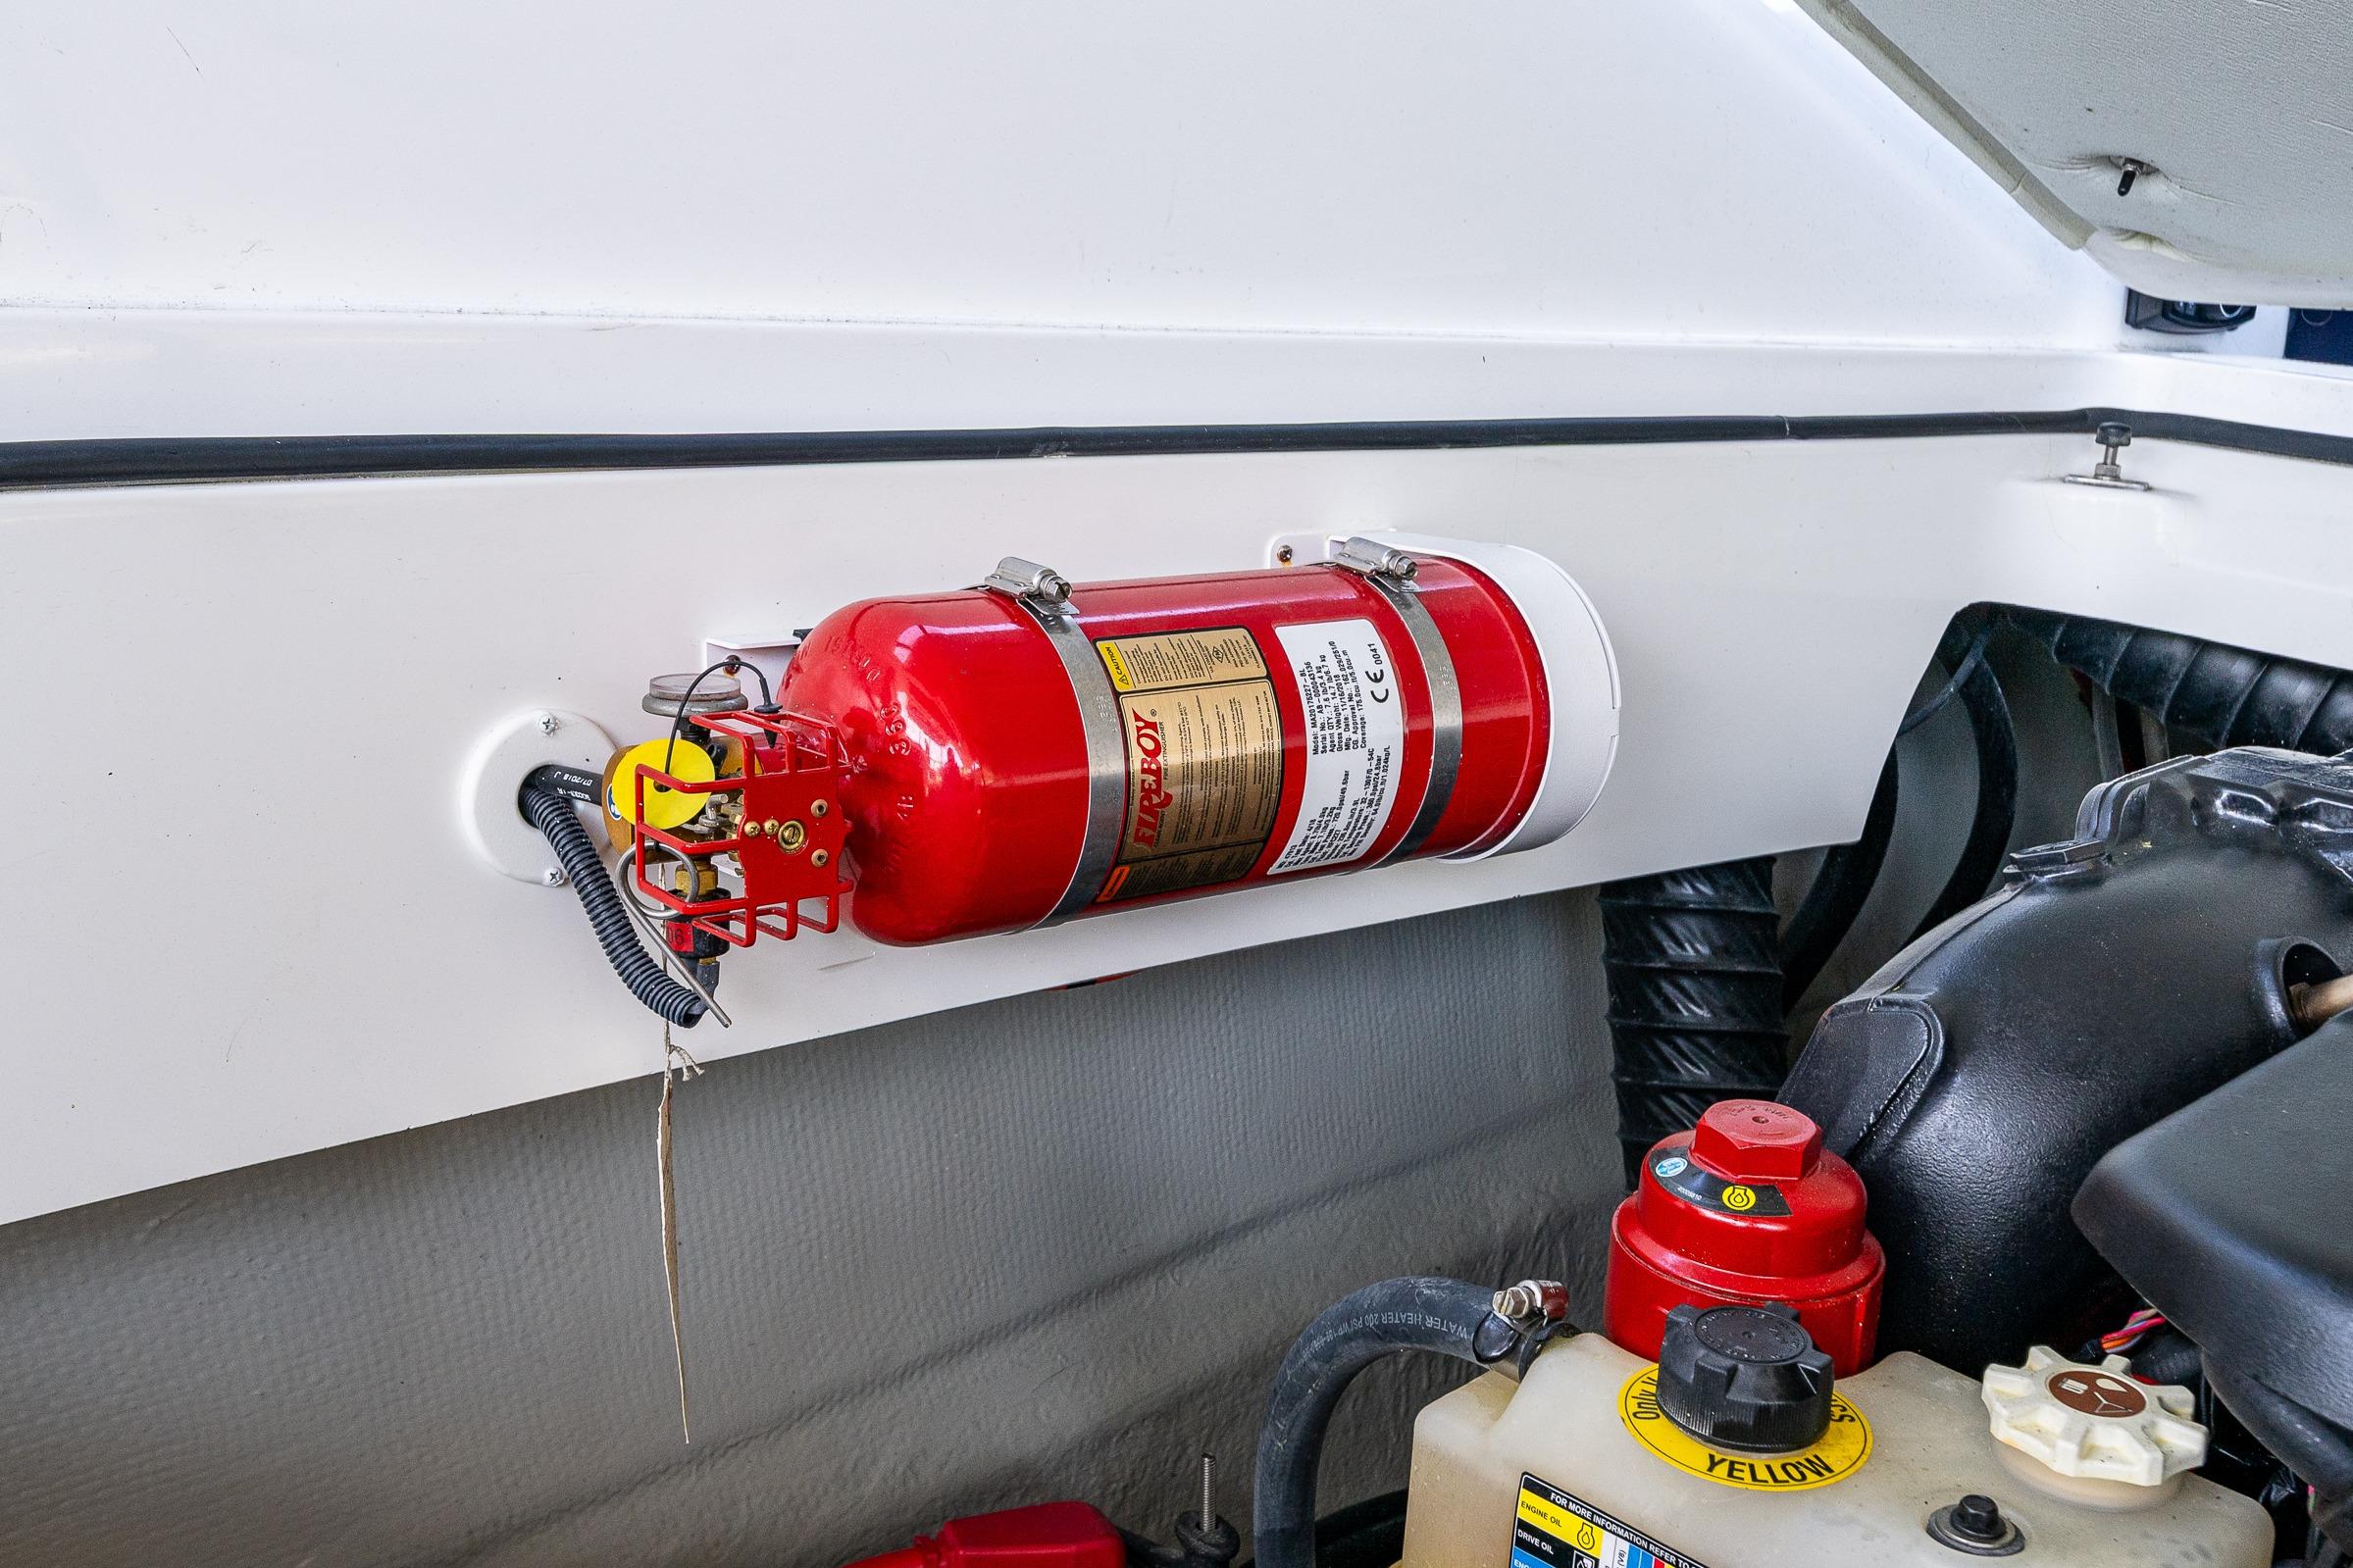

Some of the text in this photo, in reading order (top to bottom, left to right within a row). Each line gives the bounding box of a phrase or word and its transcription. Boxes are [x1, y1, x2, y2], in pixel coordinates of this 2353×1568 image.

[1105, 647, 1122, 675] CAUTION
[1367, 643, 1383, 665] 0041
[1333, 703, 1343, 730] Weight:
[1350, 705, 1358, 734] Approval
[1159, 722, 1168, 766] EXTINGUISHER
[1327, 733, 1336, 752] Agent
[563, 774, 592, 785] 07/2018
[1132, 708, 1173, 848] FIREBOY
[1364, 1313, 1378, 1328] 200
[1381, 1312, 1422, 1325] HEATER
[1425, 1315, 1468, 1340] WATER
[1706, 1453, 1836, 1485] YELLOW
[1521, 1500, 1561, 1528] ENGINE OIL
[1551, 1492, 1567, 1508] FOR
[1568, 1500, 1592, 1520] MORE
[1593, 1514, 1648, 1549] INFORMATION
[1649, 1543, 1676, 1563] REFER
[1517, 1529, 1554, 1555] DRIVE OIL
